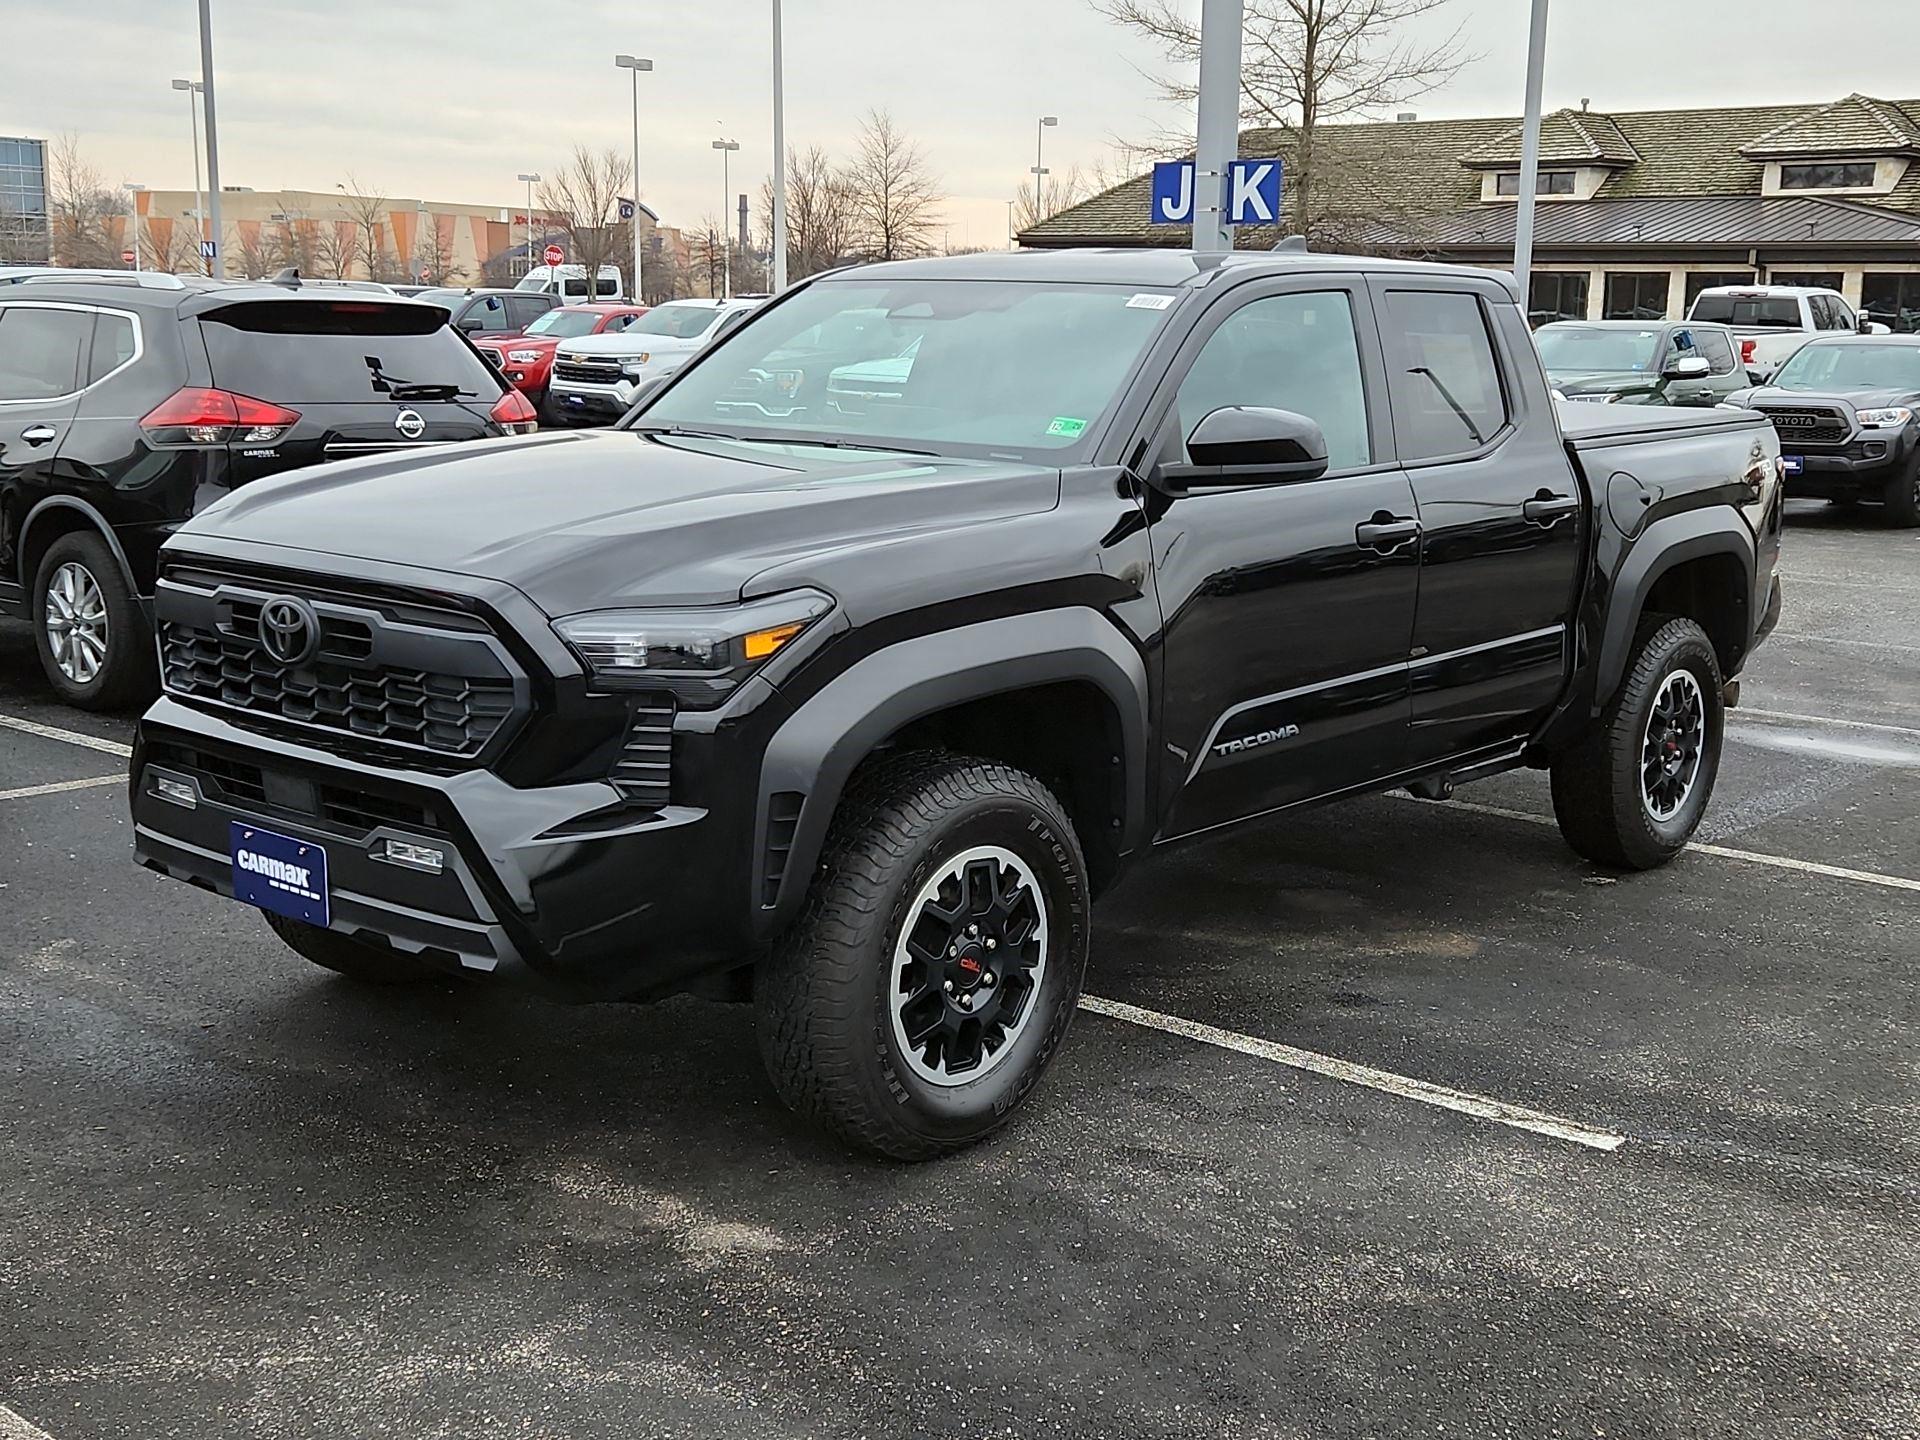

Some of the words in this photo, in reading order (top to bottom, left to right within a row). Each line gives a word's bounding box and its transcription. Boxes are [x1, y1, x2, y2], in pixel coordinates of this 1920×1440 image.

[1162, 165, 1192, 220] J
[1232, 165, 1274, 220] K
[621, 207, 632, 216] 14
[202, 242, 213, 256] N
[546, 251, 562, 261] STOP
[1213, 724, 1299, 755] TACOMA
